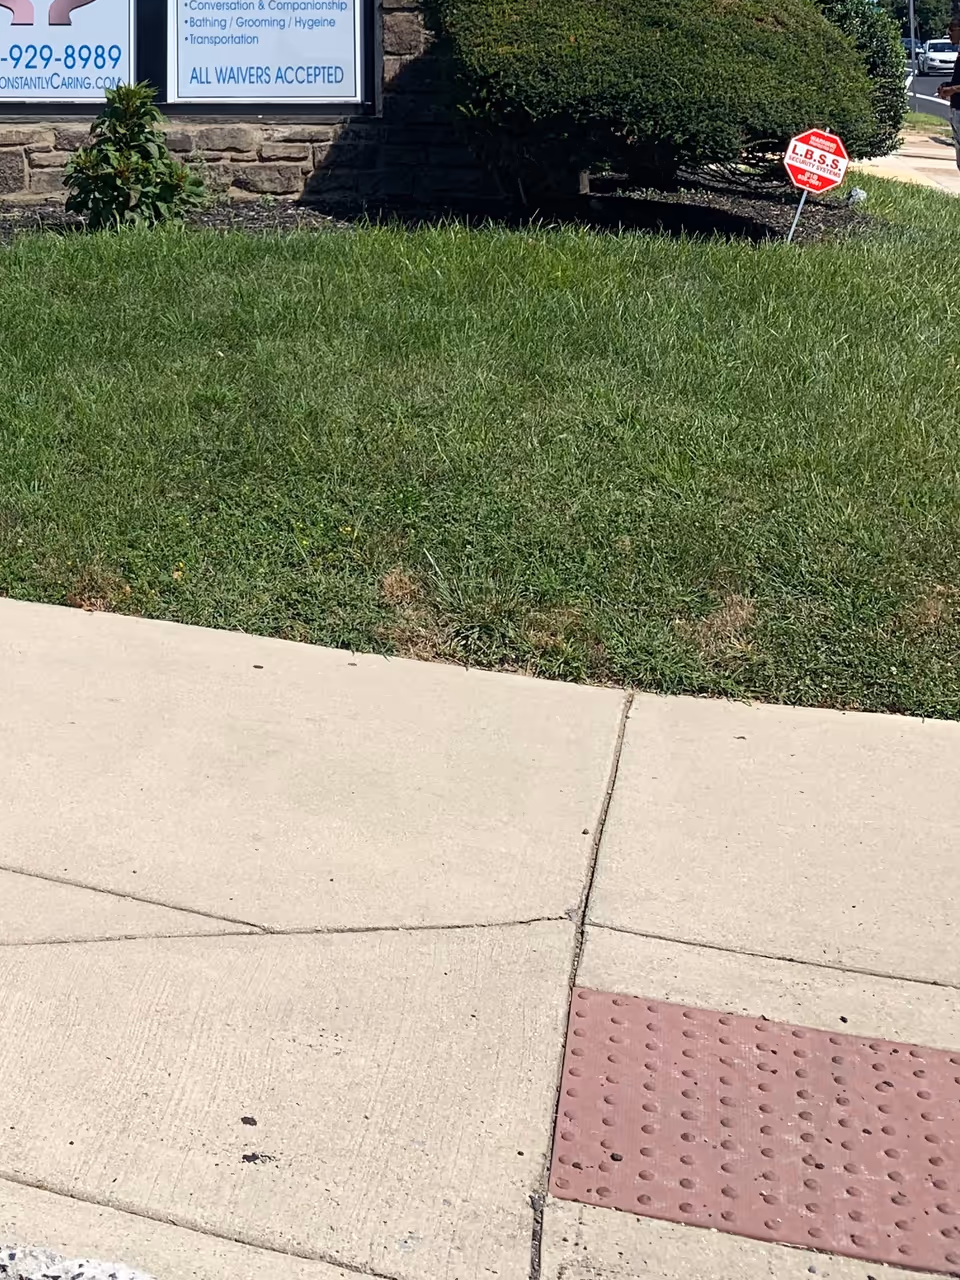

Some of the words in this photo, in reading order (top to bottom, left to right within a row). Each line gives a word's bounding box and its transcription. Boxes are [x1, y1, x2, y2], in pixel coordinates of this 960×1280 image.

[189, 0, 254, 11] Conversation
[258, 0, 265, 11] &
[268, 0, 347, 12] Companionship
[190, 17, 227, 29] Bathing
[236, 17, 285, 29] Grooming
[295, 17, 336, 29] Hygeine
[190, 34, 258, 46] Transportation
[190, 66, 211, 84] ALL
[215, 66, 270, 84] WAIVERS
[275, 66, 344, 84] ACCEPTED
[792, 144, 842, 171] L.B.S.S.
